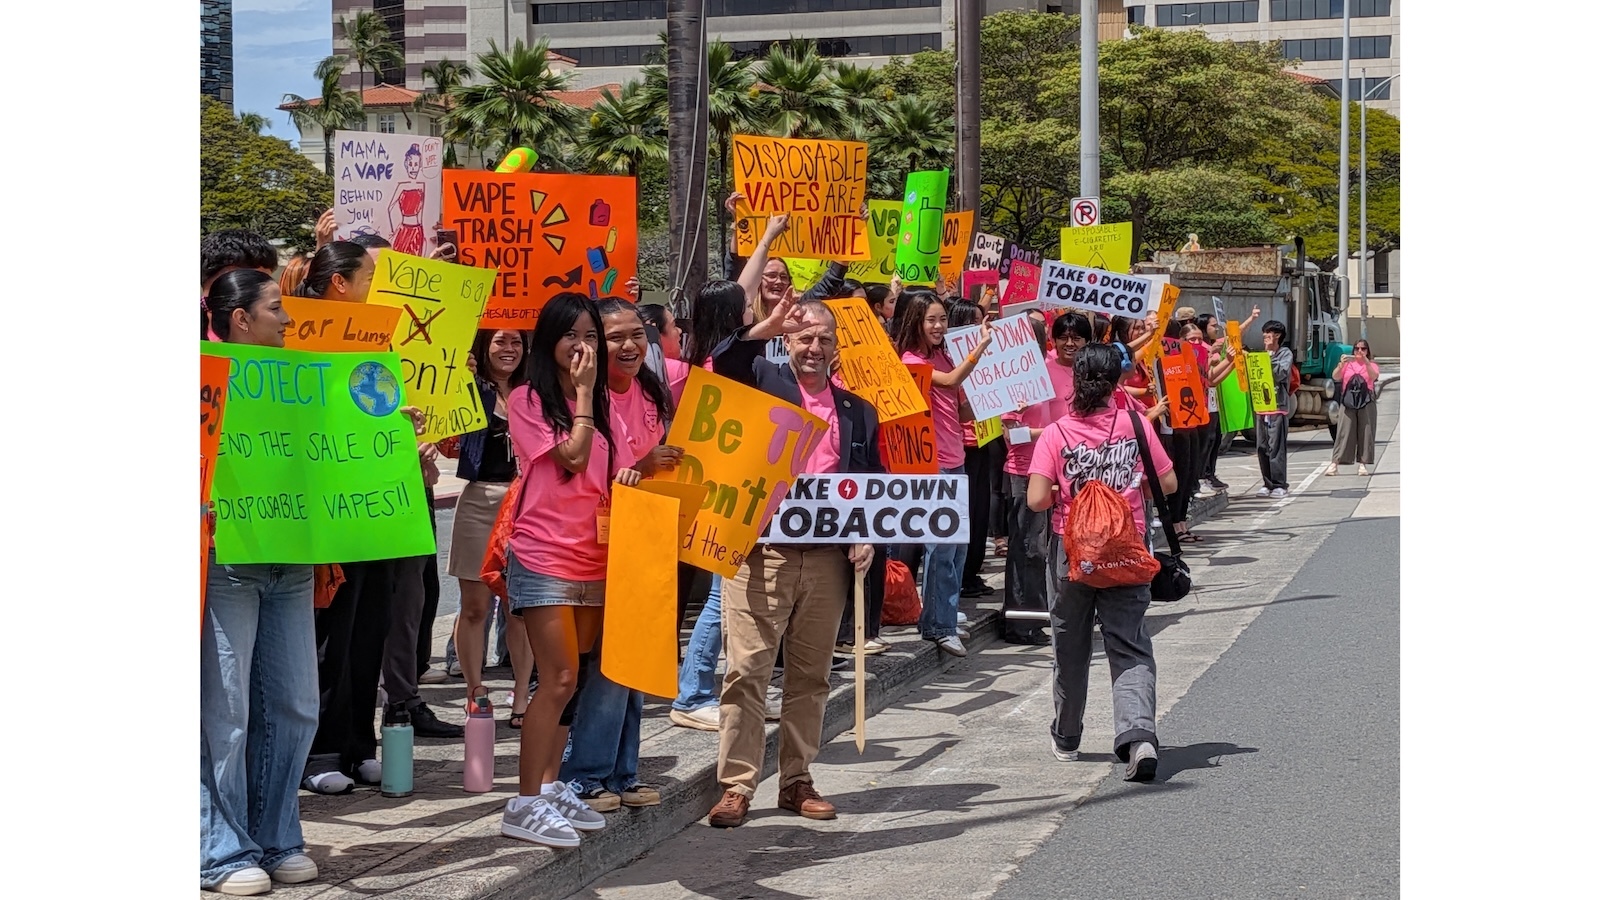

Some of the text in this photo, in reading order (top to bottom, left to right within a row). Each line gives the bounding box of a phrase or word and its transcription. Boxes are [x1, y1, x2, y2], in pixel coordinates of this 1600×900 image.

[340, 140, 390, 160] MAMA,
[736, 140, 864, 182] DISPOSABLE
[341, 162, 394, 182] A VAPE
[340, 190, 383, 205] BEHIND
[453, 182, 516, 214] VAPE
[745, 182, 856, 213] VAPES ARE
[453, 218, 533, 244] TRASH
[808, 215, 864, 255] WASTE
[977, 235, 1002, 254] Quit
[1072, 224, 1118, 235] DISPOSABLE
[461, 247, 533, 270] S NOT
[1010, 244, 1040, 265] Don't
[388, 257, 442, 296] Vape
[896, 263, 919, 281] NO
[1048, 266, 1147, 295] TAKE DOWN
[1045, 281, 1143, 313] TOBACCO
[283, 318, 334, 341] ear
[832, 305, 881, 349] ALTHY
[995, 317, 1035, 352] DOWN
[228, 358, 332, 406] ROTECT
[845, 355, 881, 390] LUNGS
[971, 389, 1002, 415] PASS
[688, 384, 742, 454] Be
[259, 430, 294, 457] THE
[306, 432, 364, 463] SALE
[373, 429, 400, 458] OF
[217, 482, 414, 524] DISPOSABLE VAPES!!
[785, 478, 959, 500] KE DOWN
[701, 525, 726, 561] the
